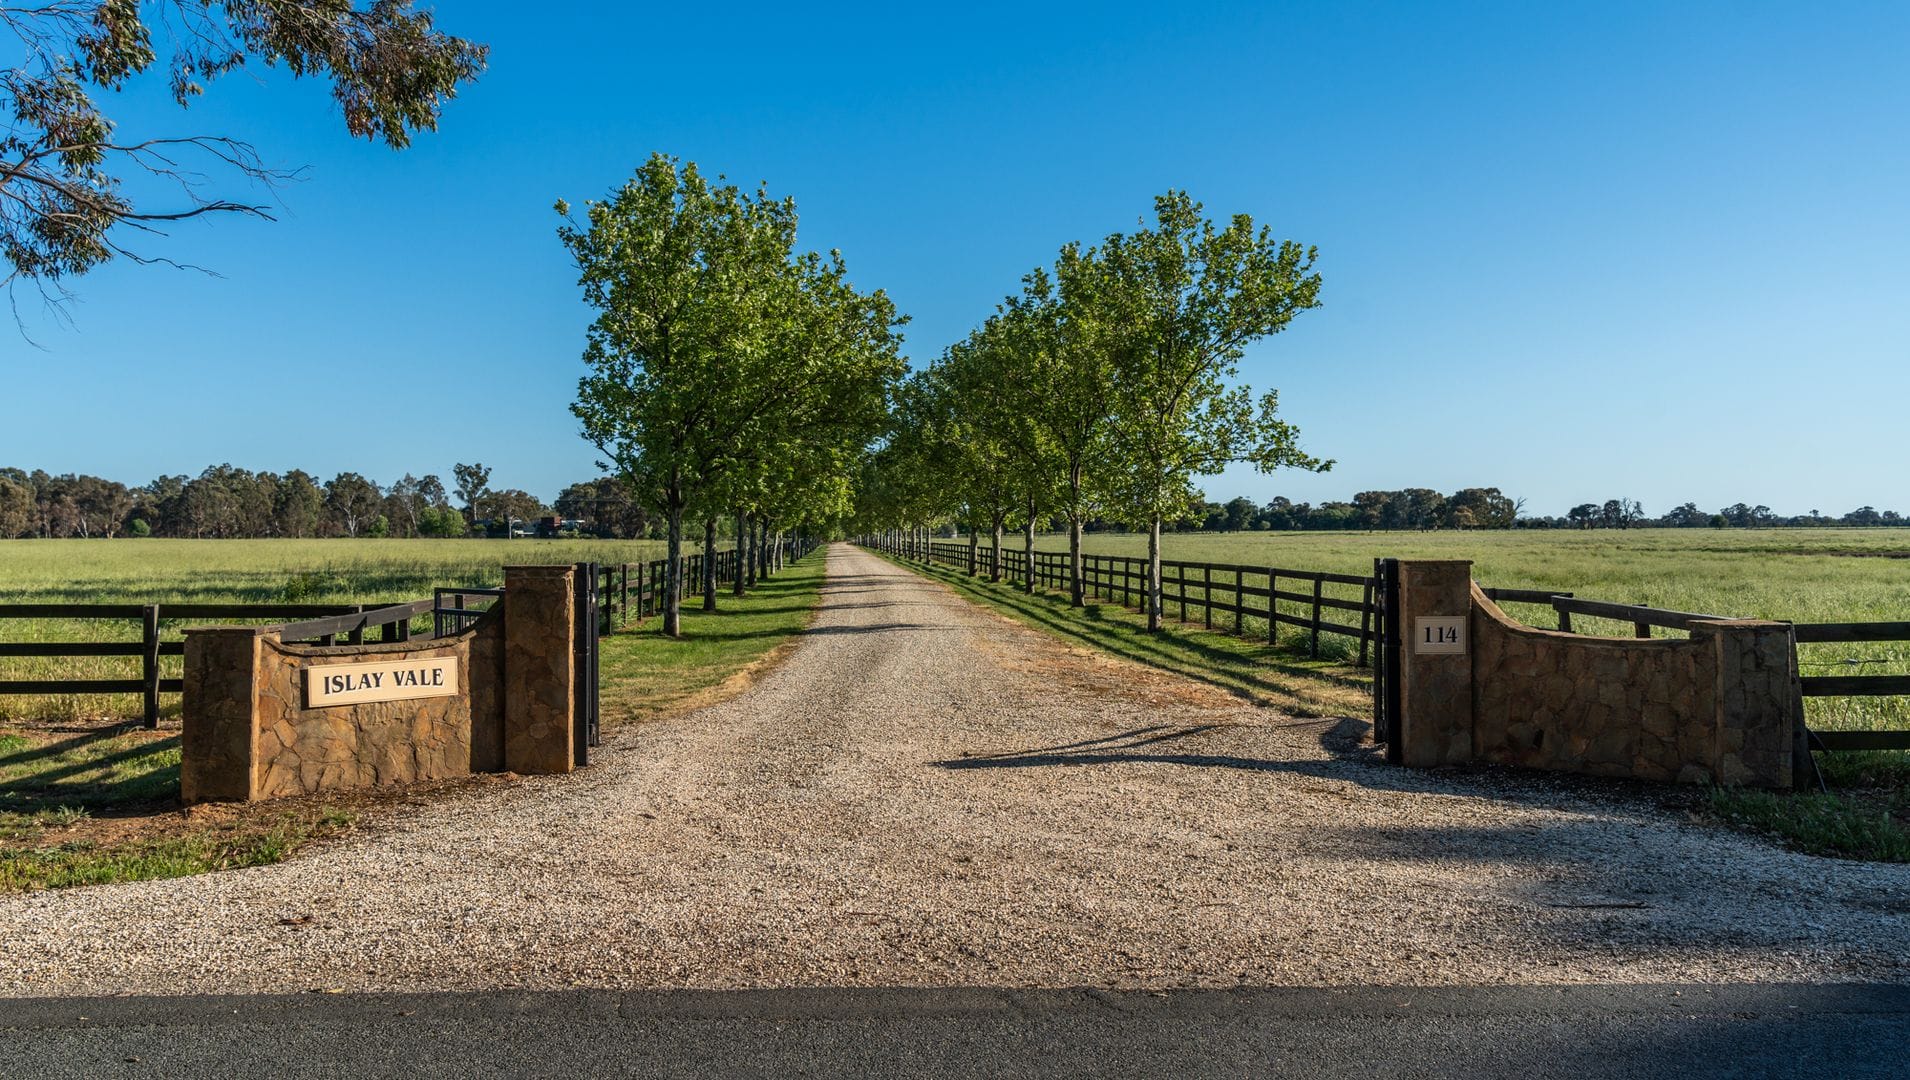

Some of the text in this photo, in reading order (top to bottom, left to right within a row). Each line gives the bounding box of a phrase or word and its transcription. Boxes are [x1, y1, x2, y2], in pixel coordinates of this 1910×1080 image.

[1424, 626, 1458, 643] 114
[324, 668, 443, 694] ISLAY VALE
